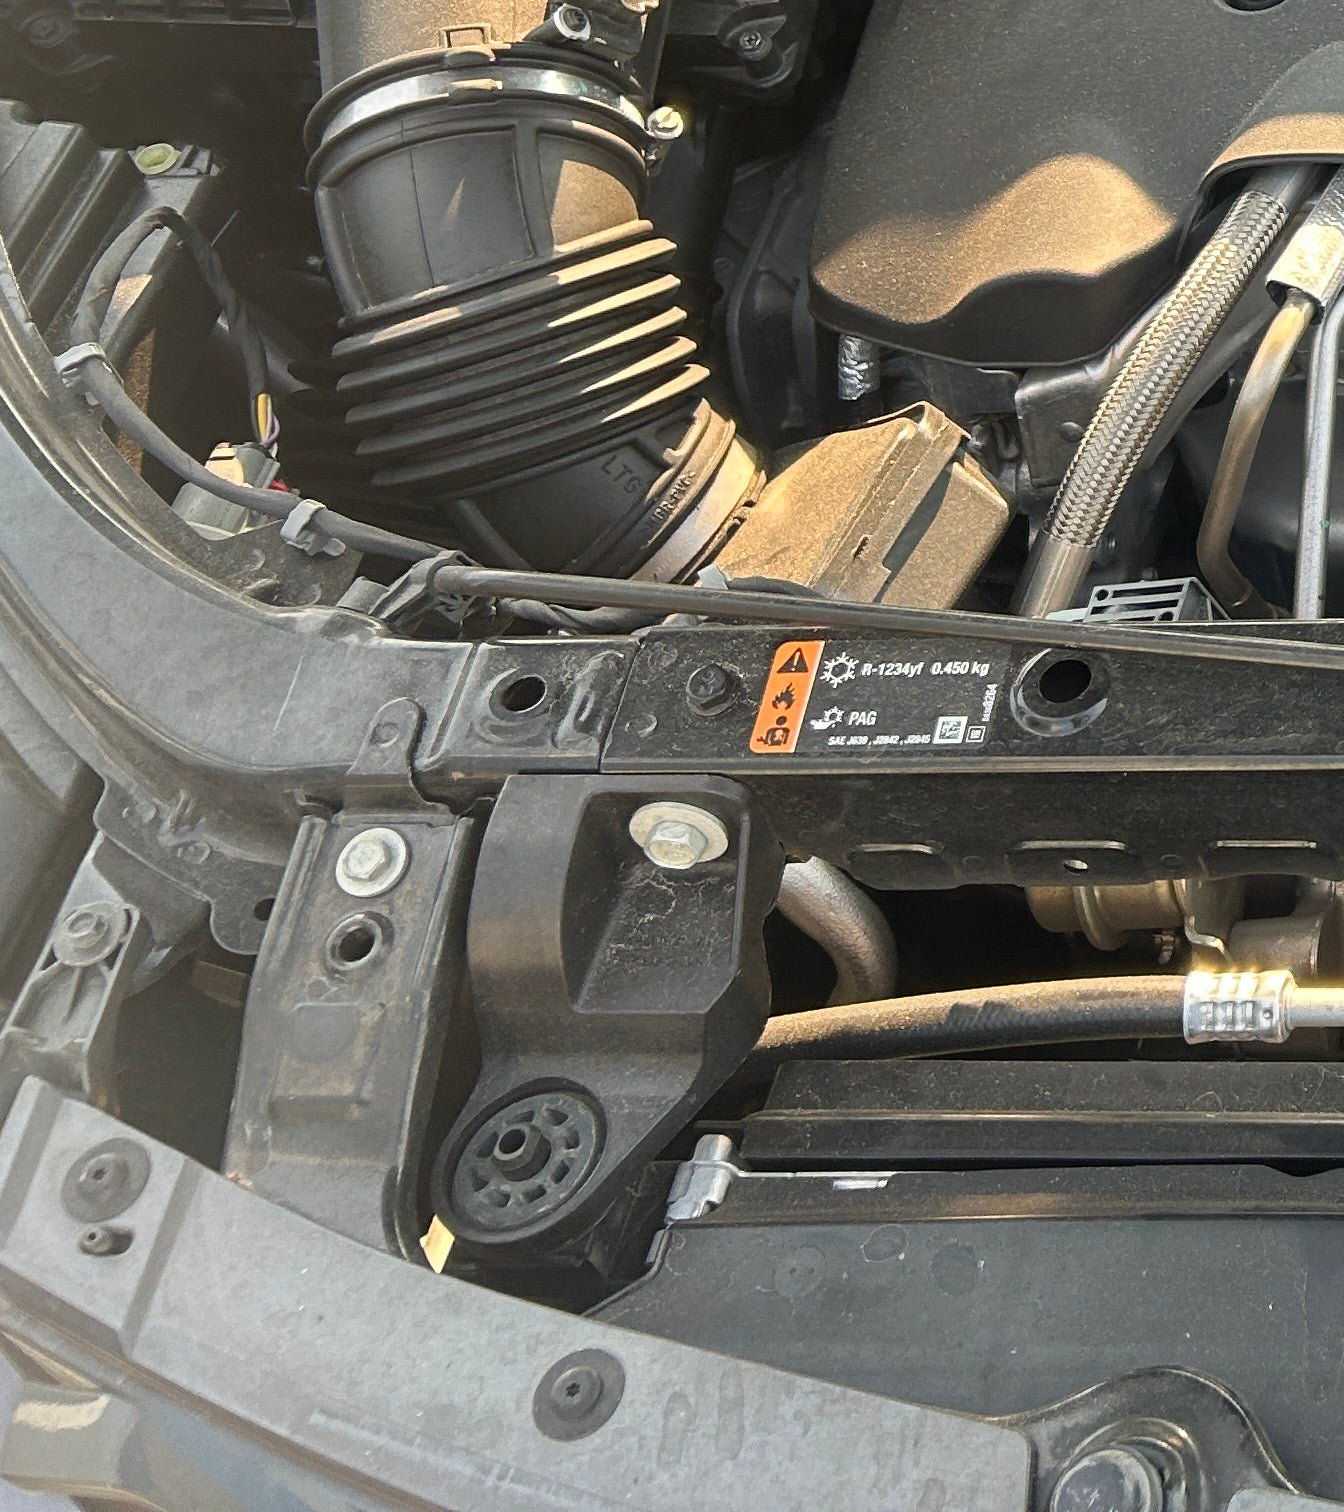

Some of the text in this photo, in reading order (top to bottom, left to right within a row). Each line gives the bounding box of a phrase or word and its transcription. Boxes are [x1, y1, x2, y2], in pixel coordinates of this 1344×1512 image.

[861, 661, 990, 678] R-1234yf 0.450 kg
[848, 711, 878, 726] PAG
